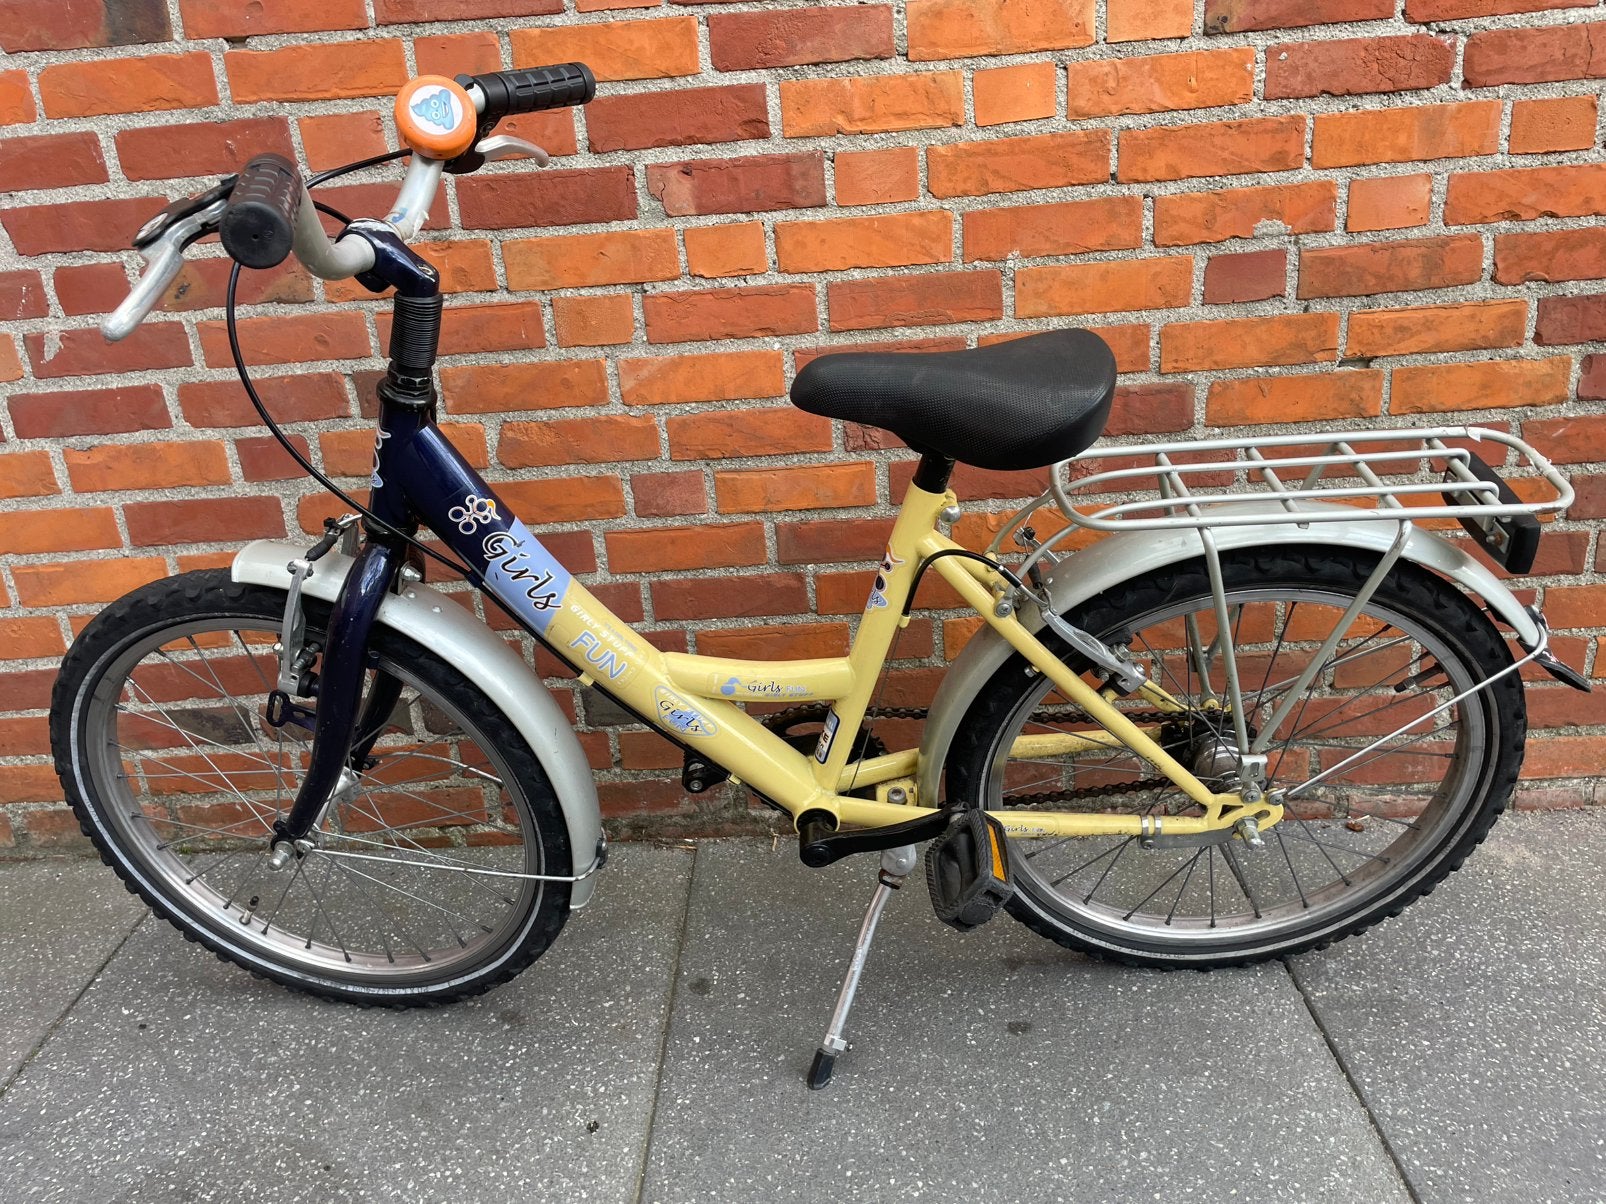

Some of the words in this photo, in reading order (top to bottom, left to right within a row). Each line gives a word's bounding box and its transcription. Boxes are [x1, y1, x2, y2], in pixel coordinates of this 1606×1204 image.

[482, 532, 562, 611] Girls
[570, 604, 600, 629] GIRLY
[570, 629, 627, 680] FUN
[747, 680, 783, 693] Girls
[660, 700, 702, 731] Girls
